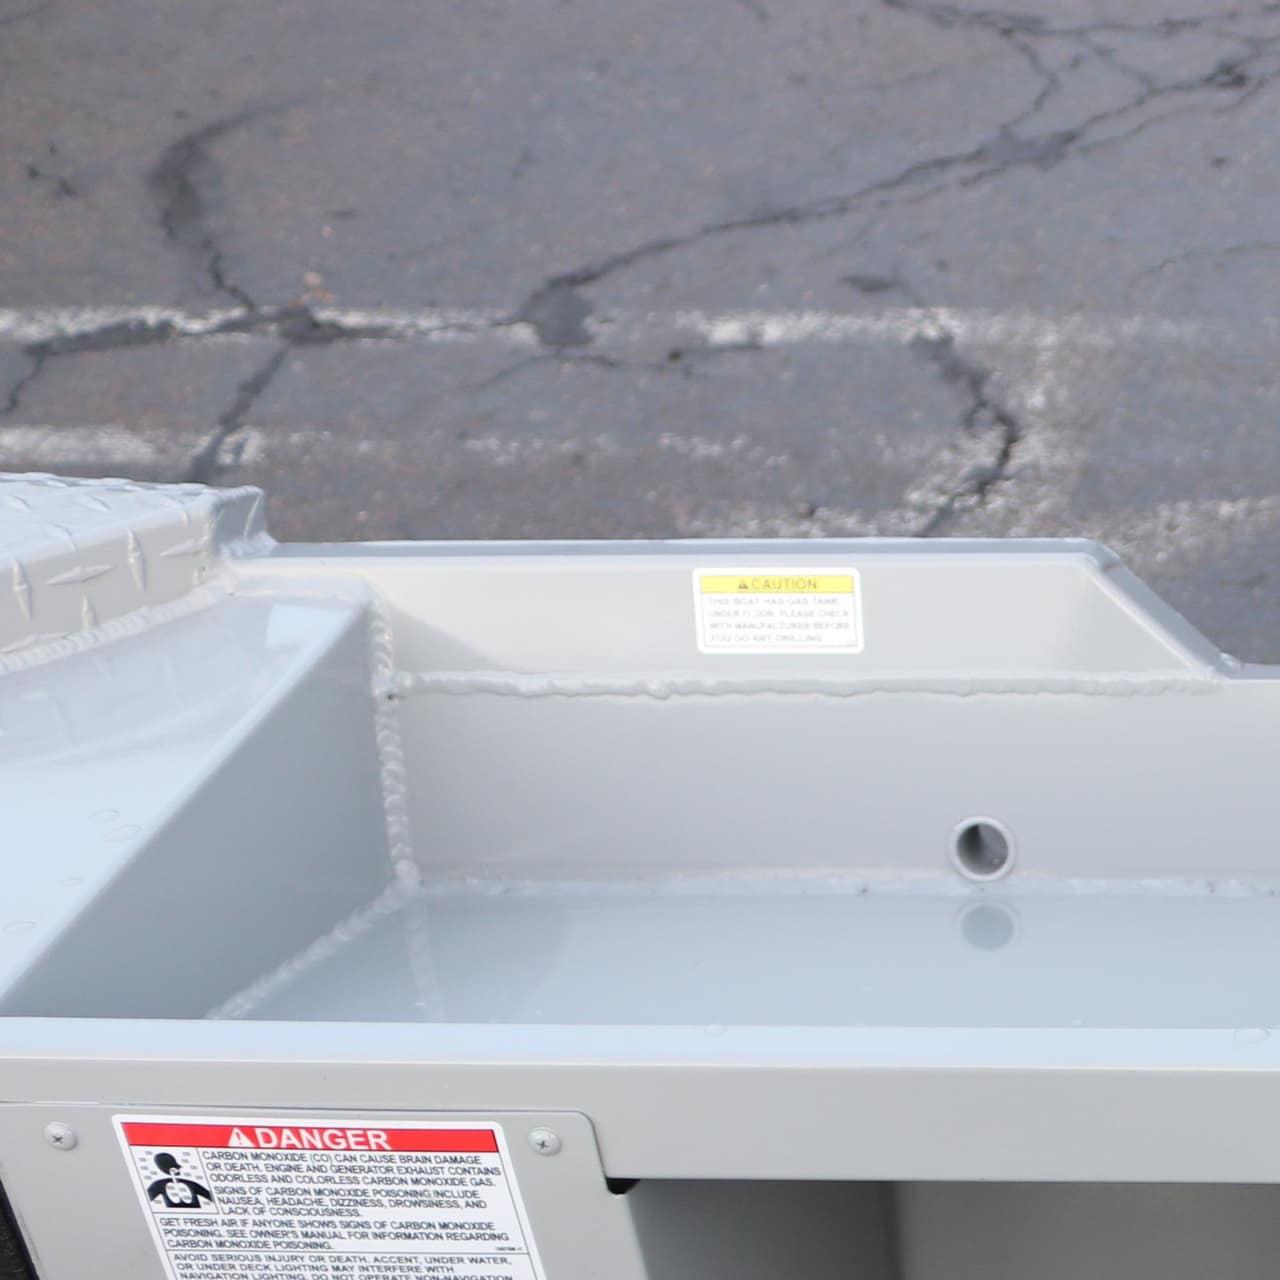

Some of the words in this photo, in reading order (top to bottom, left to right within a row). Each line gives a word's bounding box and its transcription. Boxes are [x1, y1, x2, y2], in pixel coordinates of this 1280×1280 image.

[750, 578, 818, 590] CAUTION
[255, 1127, 392, 1151] DANGER
[202, 1150, 249, 1161] CARBON
[250, 1151, 308, 1162] MONOXIDE
[309, 1153, 333, 1163] (CO)
[334, 1153, 358, 1163] CAN
[359, 1154, 397, 1164] CAUSE
[398, 1154, 433, 1164] BRAIN
[433, 1155, 482, 1165] DAMAGE
[205, 1161, 223, 1172] OR
[263, 1163, 305, 1173] ENGINE
[305, 1163, 328, 1174] AND
[329, 1164, 396, 1175] GENERATOR
[395, 1165, 445, 1176] EXHAUST
[447, 1166, 502, 1176] CONTAINS
[209, 1172, 269, 1184] ODORLESS
[270, 1174, 294, 1184] AND
[294, 1174, 361, 1185] COLORLESS
[361, 1175, 409, 1186] CARBON
[409, 1177, 469, 1187] MONOXIDE
[213, 1185, 248, 1195] SIGNS
[248, 1186, 263, 1196] OF
[265, 1186, 313, 1197] CARBON
[313, 1187, 371, 1198] MONOXIDE
[371, 1188, 432, 1199] POISONING
[432, 1189, 480, 1199] INCLUDE
[464, 1200, 487, 1209] AND
[220, 1206, 251, 1216] LACK
[252, 1206, 267, 1216] OF
[159, 1217, 181, 1227] GET
[182, 1217, 219, 1227] FRESH
[220, 1218, 239, 1228] AIR
[239, 1218, 249, 1228] IF
[252, 1219, 297, 1229] ANYONE
[297, 1219, 338, 1229] SHOWS
[338, 1220, 372, 1230] SIGNS
[373, 1220, 388, 1230] OF
[390, 1220, 437, 1230] CARBON
[437, 1221, 495, 1231] MONOXIDE
[225, 1229, 248, 1239] SEE
[248, 1229, 300, 1239] OWNER'S
[300, 1230, 346, 1240] MANUAL
[346, 1230, 371, 1240] FOR
[371, 1231, 444, 1241] INFORMATION
[445, 1232, 510, 1241] REGARDING
[167, 1239, 214, 1248] CARBON
[214, 1239, 272, 1249] MONOXIDE
[173, 1253, 209, 1262] AVOID
[210, 1253, 263, 1262] SERIOUS
[264, 1254, 305, 1263] INJURY
[308, 1254, 326, 1263] OR
[424, 1256, 466, 1265] UNDER
[176, 1262, 194, 1271] OR
[195, 1263, 237, 1271] UNDER
[238, 1263, 272, 1272] DECK
[274, 1264, 329, 1272] LIGHTING
[330, 1264, 355, 1272] MAY
[357, 1264, 423, 1274] INTERFERE
[424, 1265, 455, 1273] WITH
[179, 1272, 250, 1280] NAVIGATION
